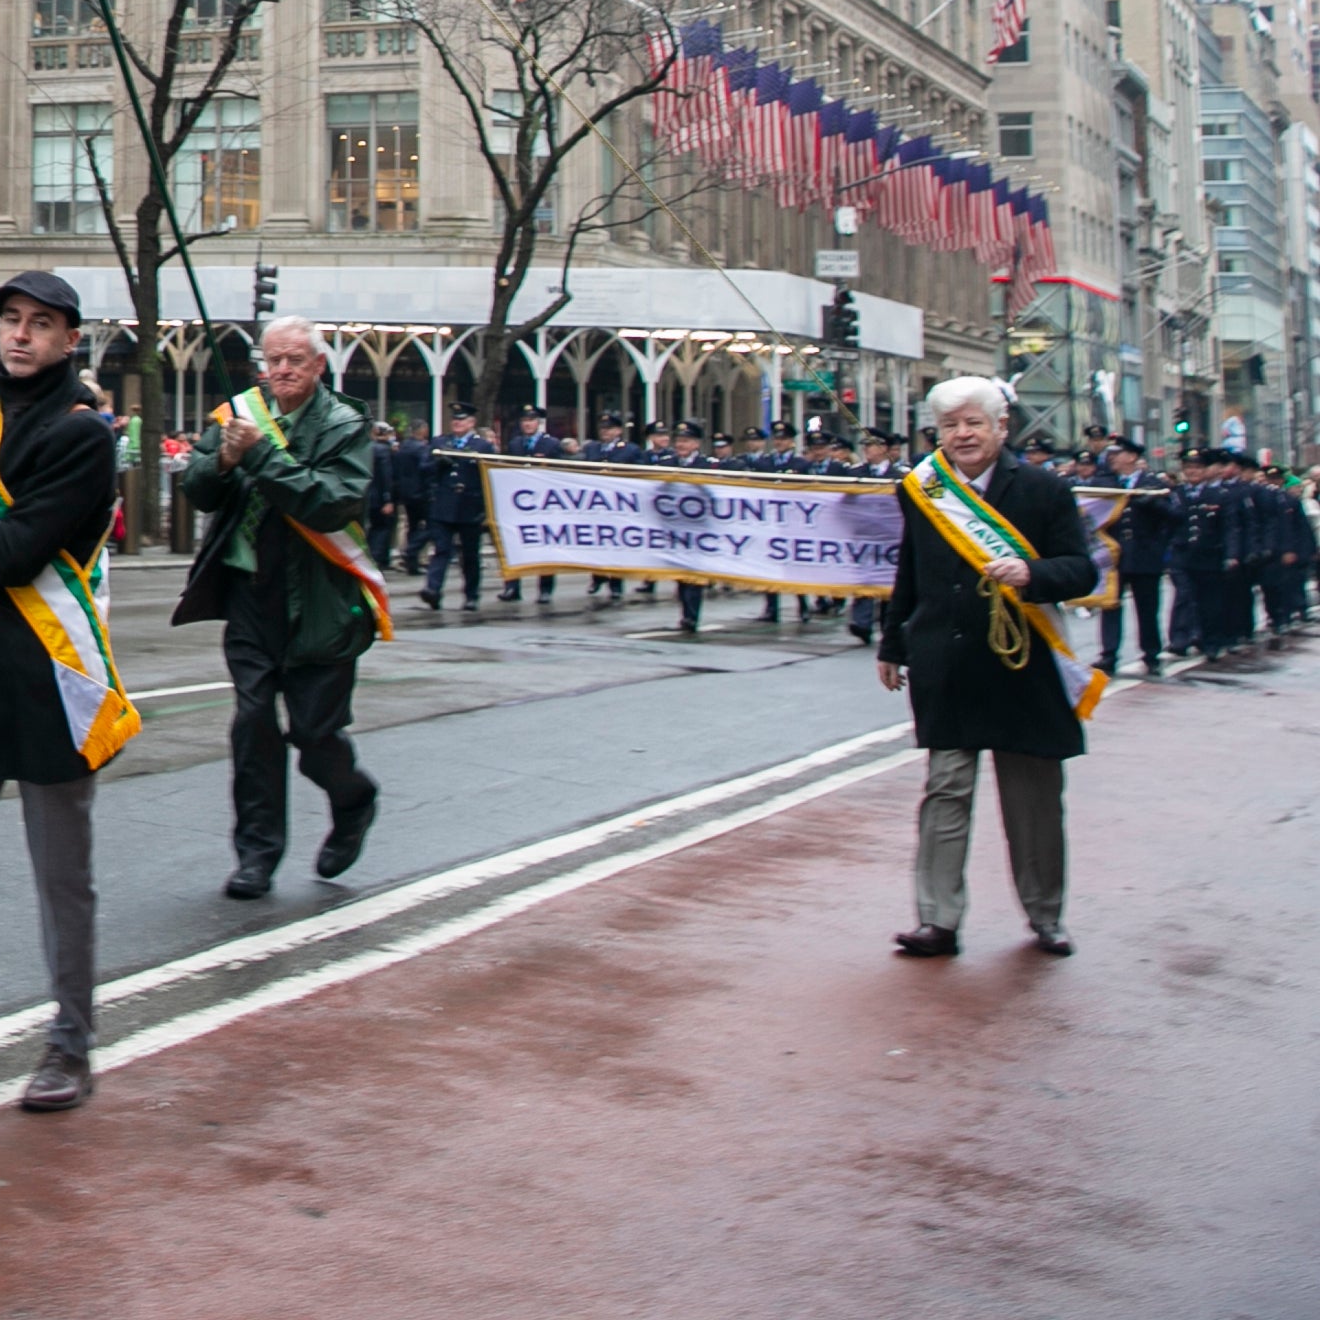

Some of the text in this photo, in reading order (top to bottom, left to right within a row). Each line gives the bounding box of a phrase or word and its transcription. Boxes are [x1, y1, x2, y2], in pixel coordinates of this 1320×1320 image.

[512, 489, 820, 525] CAVAN COUNTY
[518, 524, 752, 555] EMERGENCY
